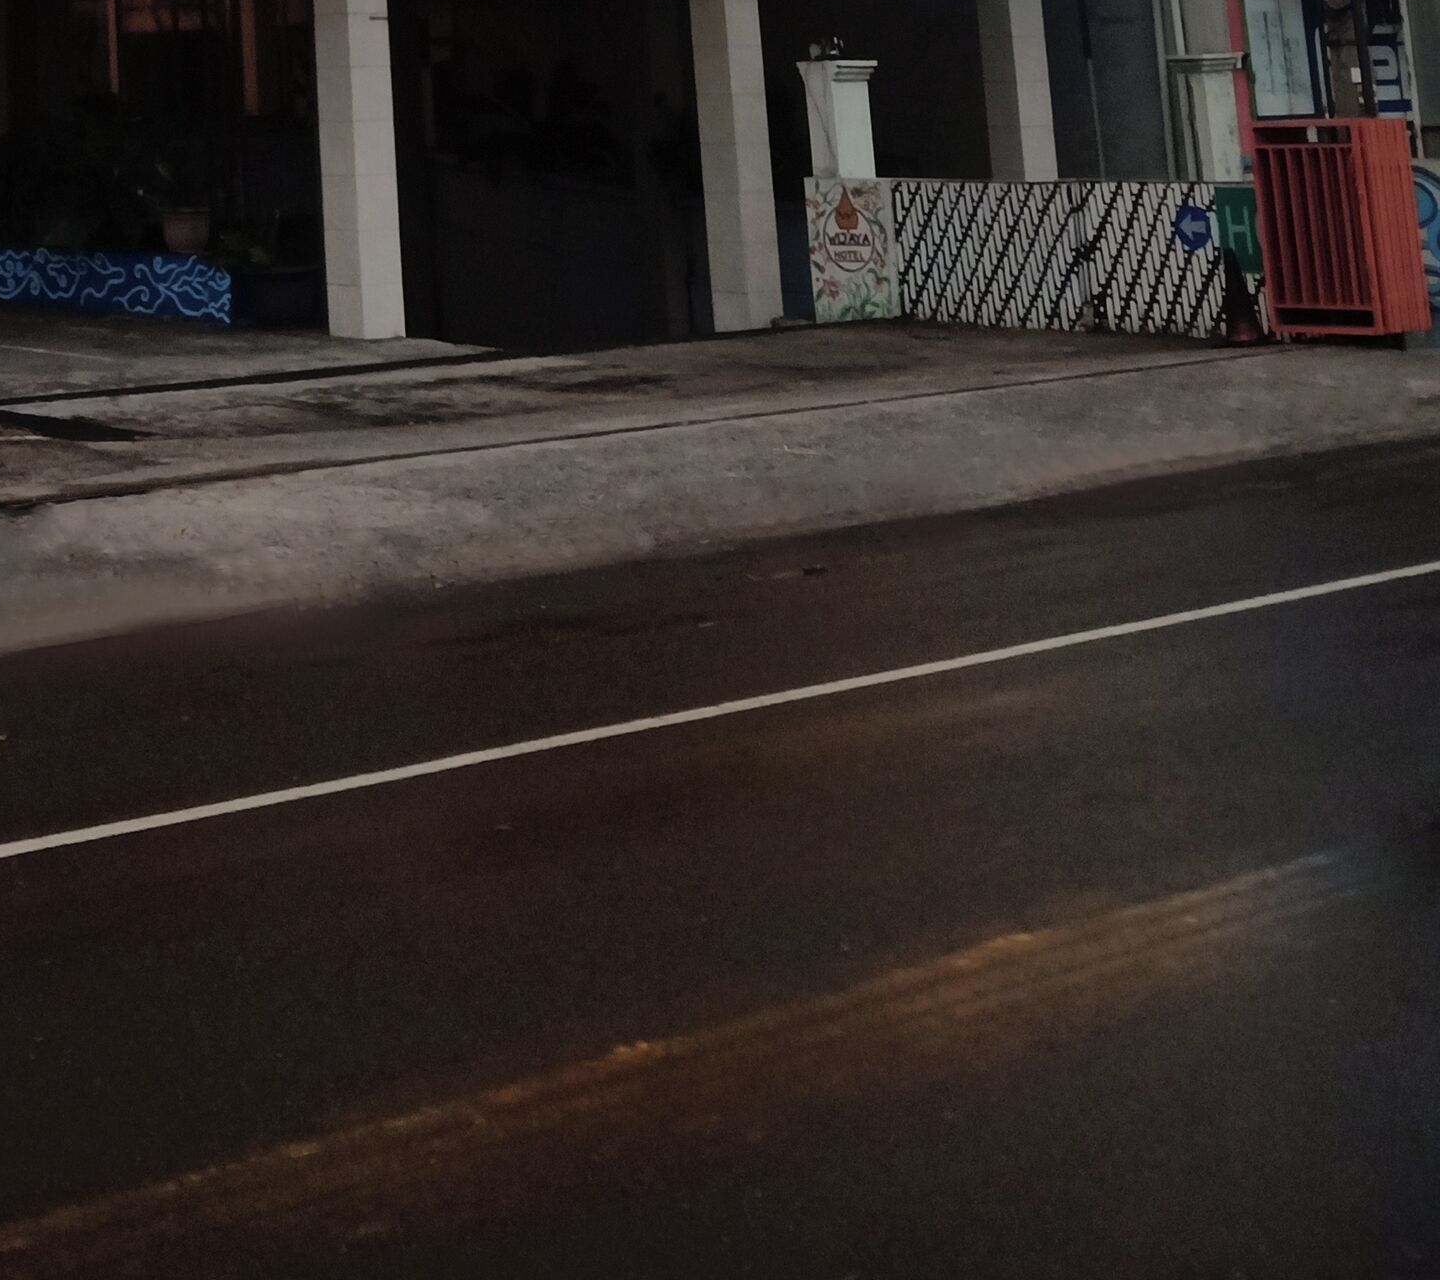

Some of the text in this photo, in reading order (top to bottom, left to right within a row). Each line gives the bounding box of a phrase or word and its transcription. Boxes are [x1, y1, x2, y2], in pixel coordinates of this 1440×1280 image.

[1225, 205, 1253, 255] H
[826, 231, 871, 246] WIJAYA
[833, 249, 865, 263] HOTEL
